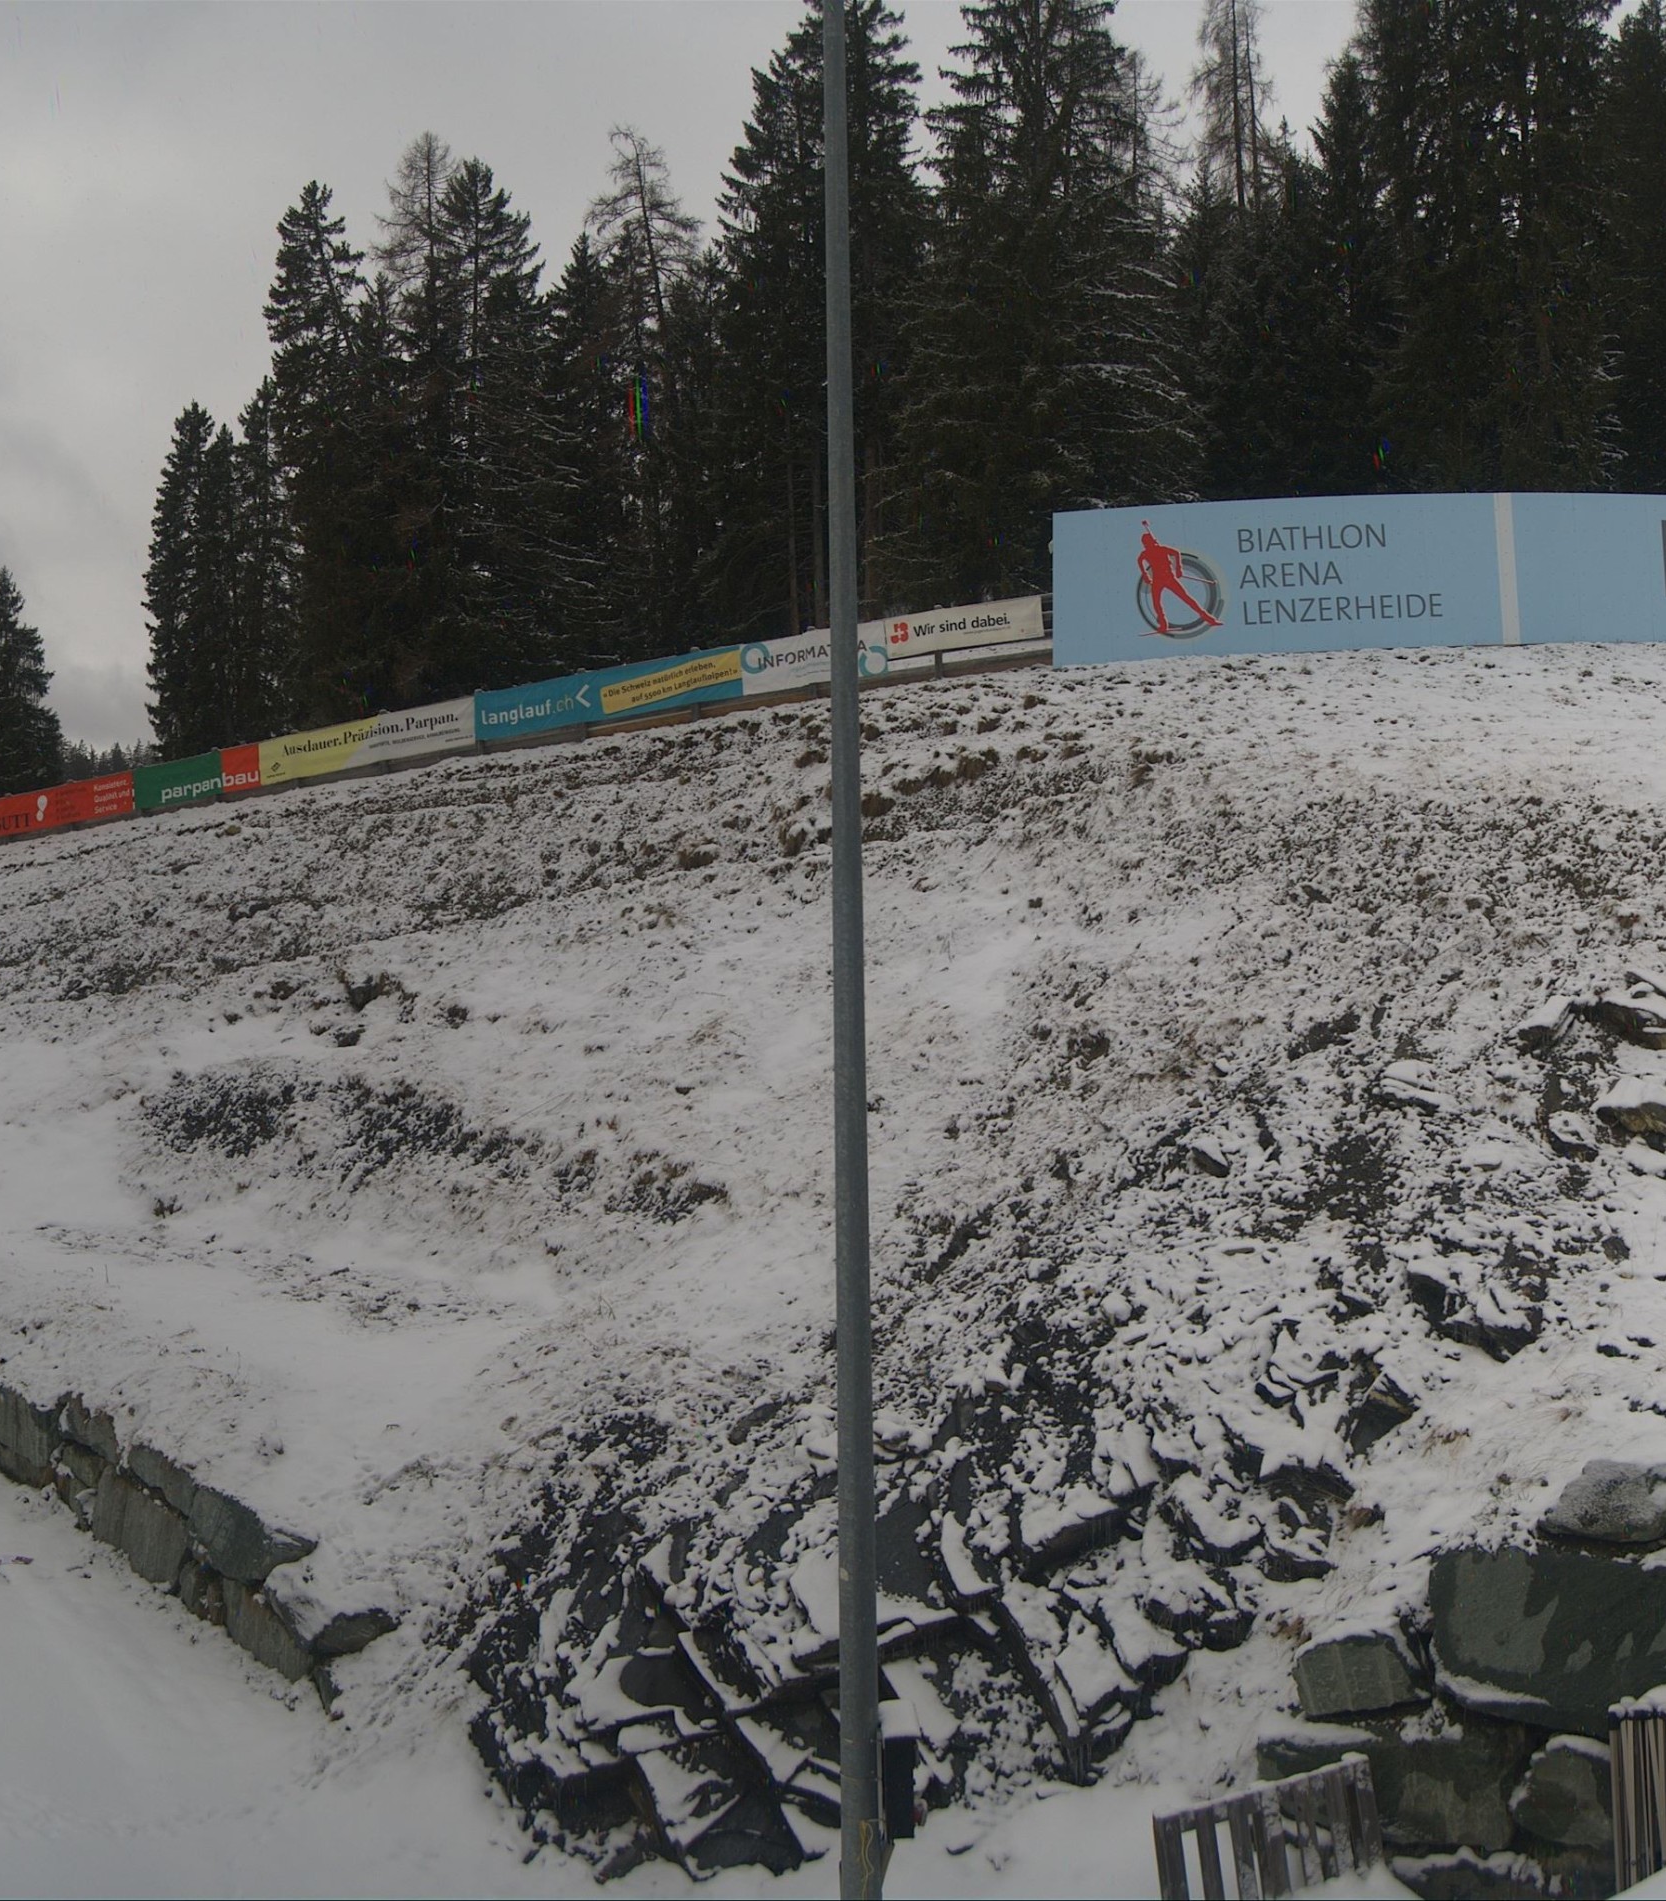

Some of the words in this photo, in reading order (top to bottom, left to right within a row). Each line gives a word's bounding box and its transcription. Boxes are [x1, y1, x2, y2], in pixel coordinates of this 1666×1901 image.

[1237, 523, 1386, 553] BIATHLON
[1239, 561, 1343, 589] ARENA
[1243, 593, 1443, 625] LENZERHEIDE
[913, 624, 936, 637] Wir
[939, 618, 966, 633] sind
[971, 612, 1011, 630] dabei.
[622, 679, 652, 694] Schweiz
[662, 687, 674, 696] km
[481, 695, 574, 725] langlauf.ch
[283, 735, 344, 757] Ausdauer.
[344, 721, 404, 745] Präzision.
[406, 711, 459, 733] Parpan.
[161, 770, 259, 803] parpanbau
[93, 803, 119, 815] Service
